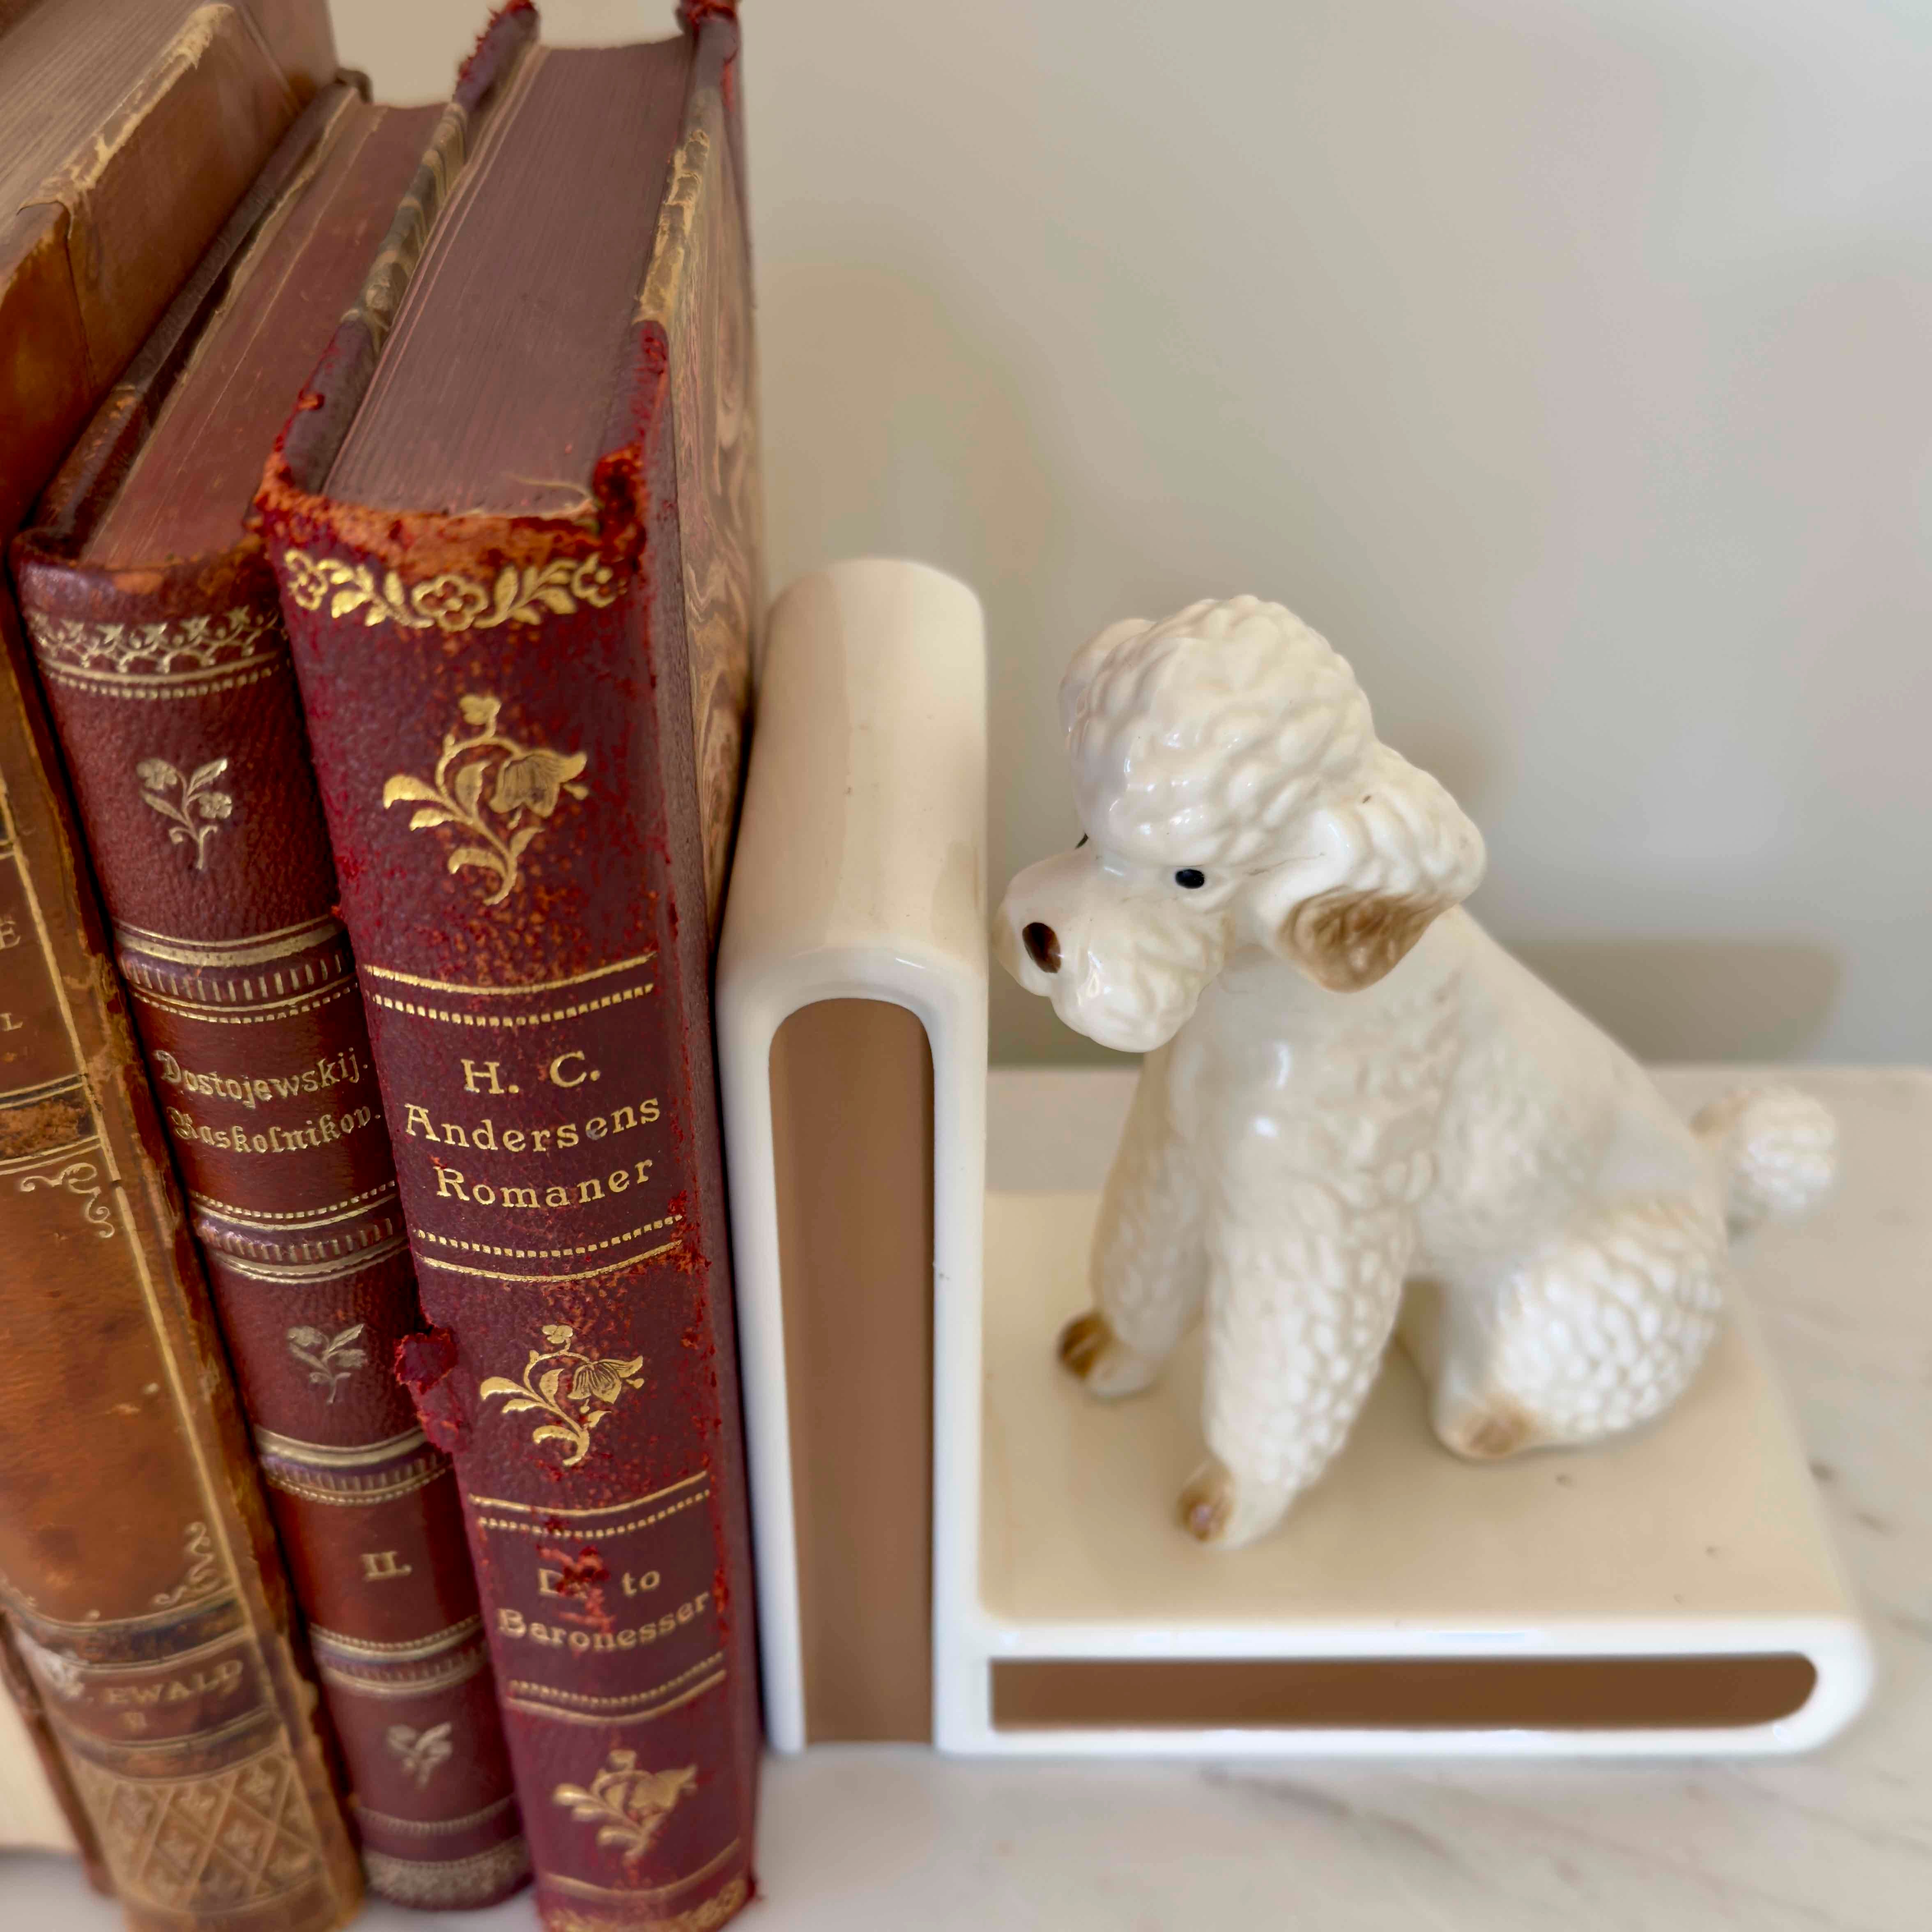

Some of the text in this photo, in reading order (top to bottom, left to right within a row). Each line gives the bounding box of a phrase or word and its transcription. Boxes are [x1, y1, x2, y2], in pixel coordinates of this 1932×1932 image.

[154, 1047, 368, 1109] Dostojewskij.
[460, 1051, 601, 1094] H. C.
[404, 1097, 661, 1152] Andersens
[433, 1159, 653, 1209] Romaner
[621, 1570, 660, 1596] to
[497, 1591, 710, 1652] Baronesser
